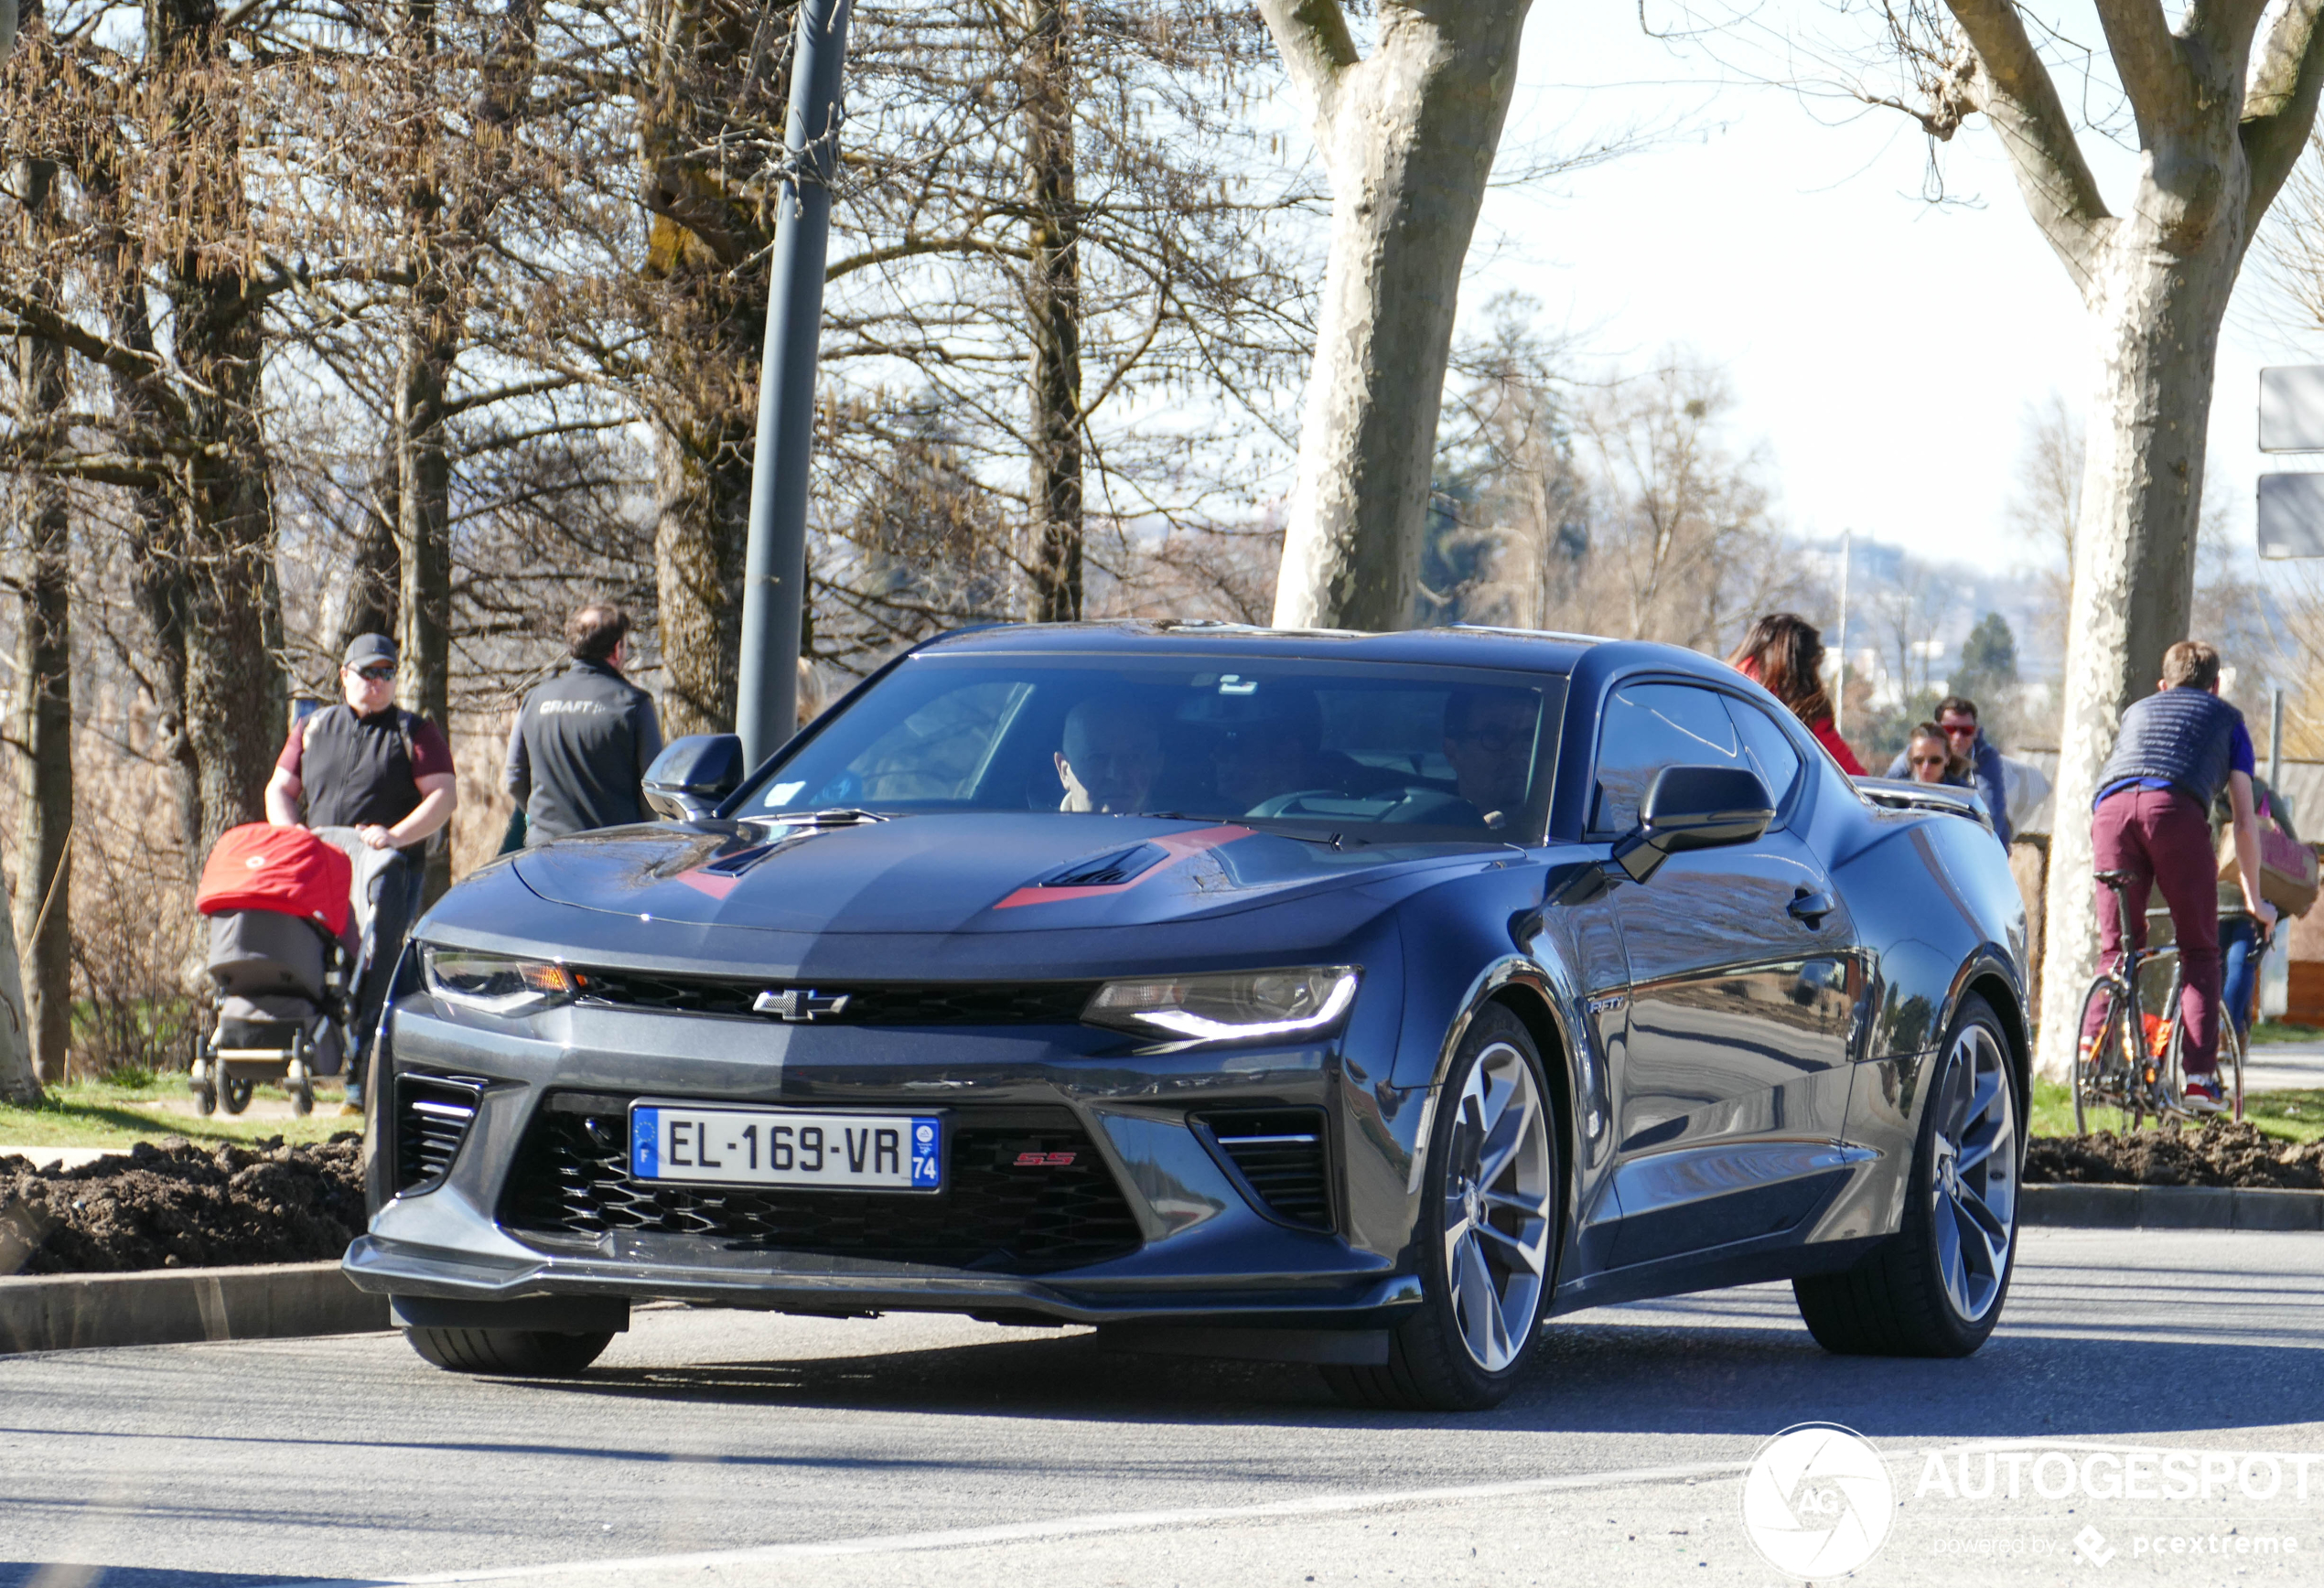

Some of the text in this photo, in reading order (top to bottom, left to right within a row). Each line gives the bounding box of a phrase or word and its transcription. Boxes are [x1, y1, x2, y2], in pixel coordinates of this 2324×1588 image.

[540, 700, 593, 714] CRAFT
[670, 1121, 899, 1175] EL-169-VR
[640, 1149, 649, 1163] F
[1013, 1153, 1077, 1165] SS
[912, 1156, 937, 1179] 74
